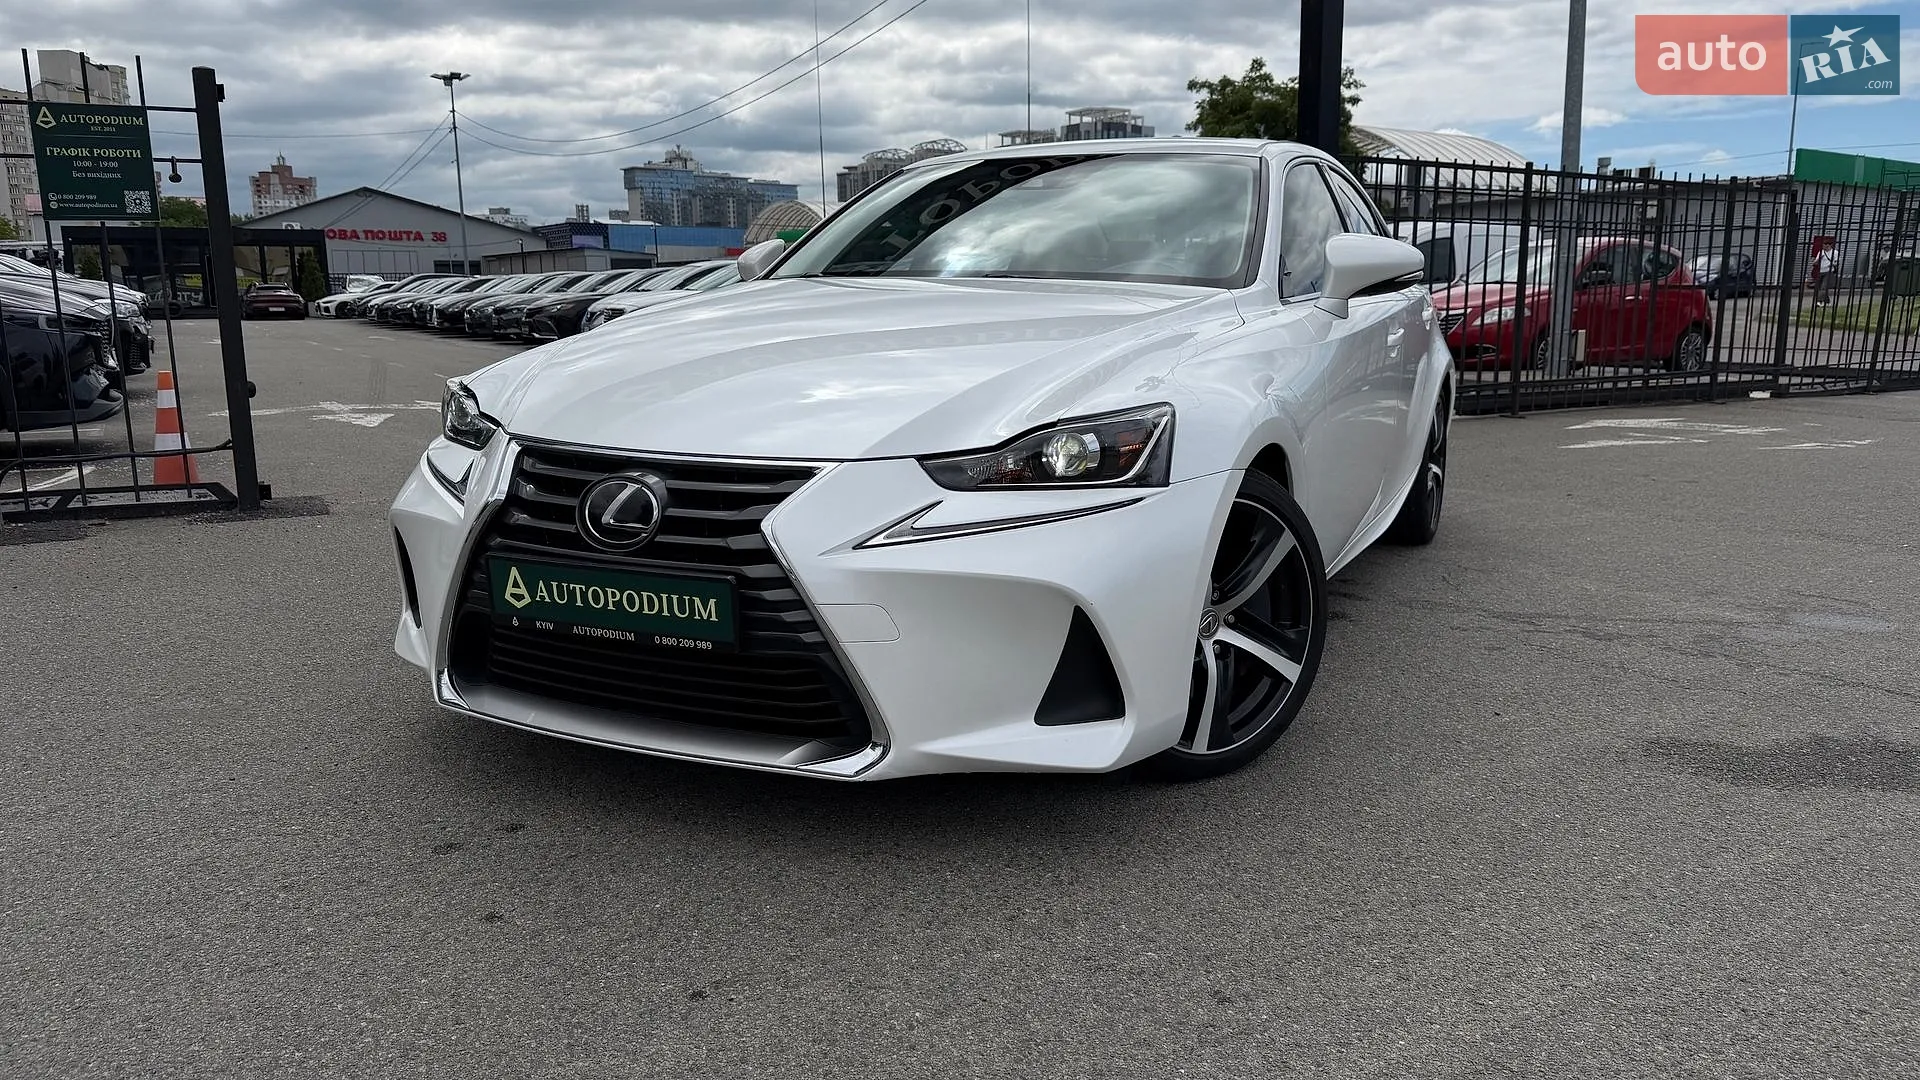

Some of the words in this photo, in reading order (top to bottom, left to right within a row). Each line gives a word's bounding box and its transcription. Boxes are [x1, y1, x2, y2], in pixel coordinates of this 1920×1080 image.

[59, 113, 144, 126] AUTOPODIUM
[46, 146, 91, 158] ГРАФІК
[94, 148, 142, 158] РОБОТИ
[87, 171, 122, 179] вихідних
[326, 228, 360, 240] ОВА
[362, 229, 424, 241] ПОШТА
[431, 231, 448, 242] 38
[535, 580, 719, 622] AUTOPODIUM
[535, 620, 554, 630] KYIV
[572, 625, 635, 641] AUTOPODIUM
[654, 635, 660, 644] 0
[661, 636, 678, 646] 800
[679, 638, 695, 648] 209
[696, 640, 713, 650] 989
